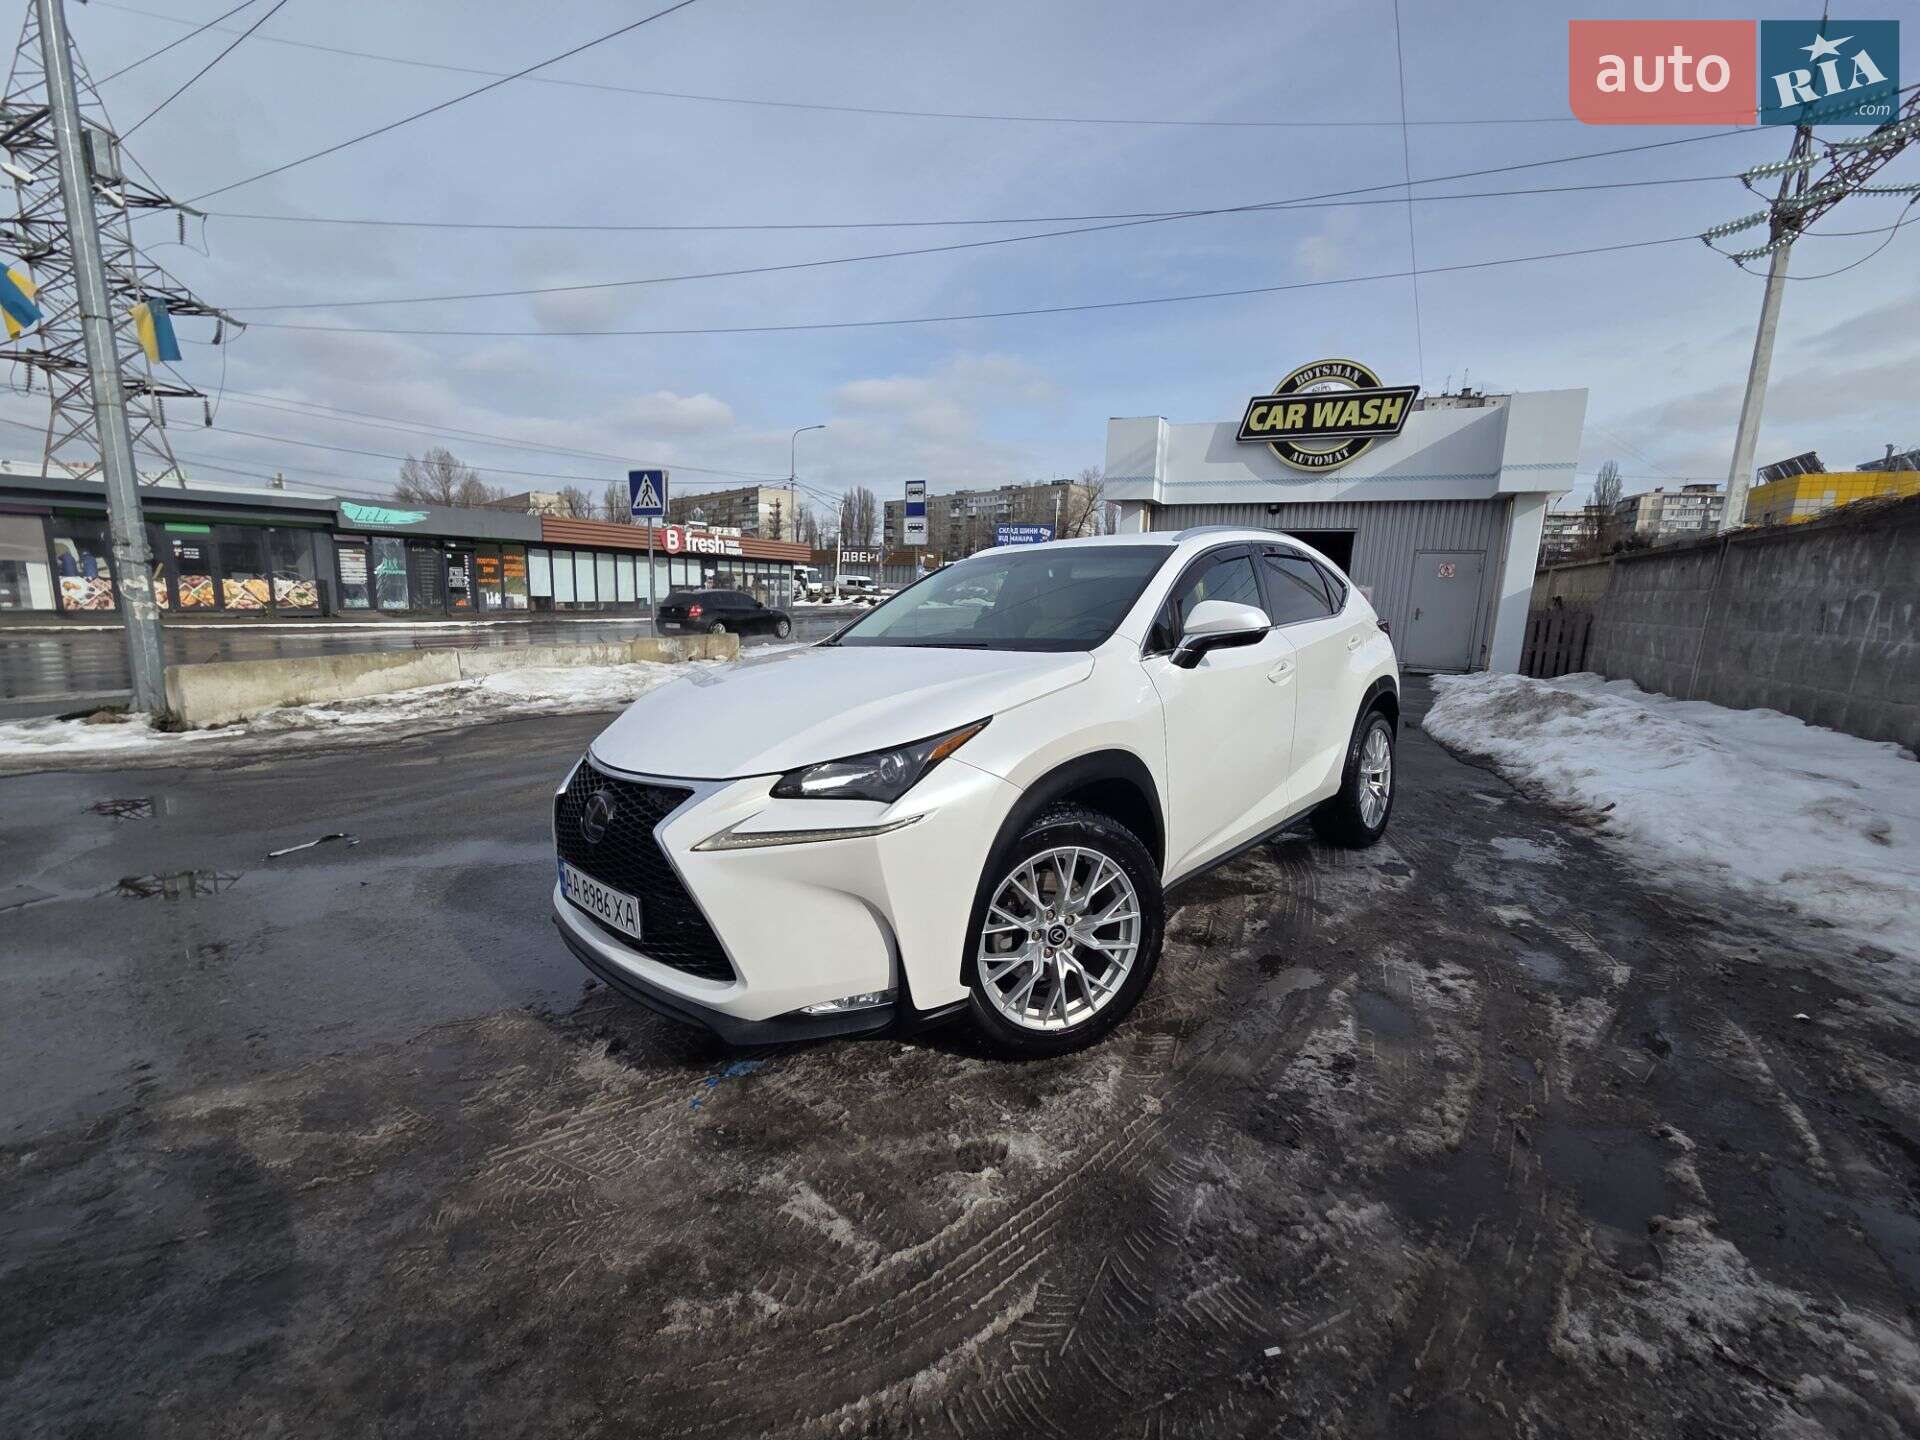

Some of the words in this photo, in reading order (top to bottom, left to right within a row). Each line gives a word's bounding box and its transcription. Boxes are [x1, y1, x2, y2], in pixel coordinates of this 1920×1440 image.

[1295, 365, 1362, 386] BOTSMAN
[1249, 403, 1308, 432] CAR
[1312, 396, 1404, 428] WASH
[1289, 447, 1350, 466] AUTOMAT
[667, 530, 679, 549] B
[686, 532, 725, 553] fresh
[566, 869, 581, 901] AA
[582, 880, 611, 918] 8986
[612, 895, 636, 932] XA
